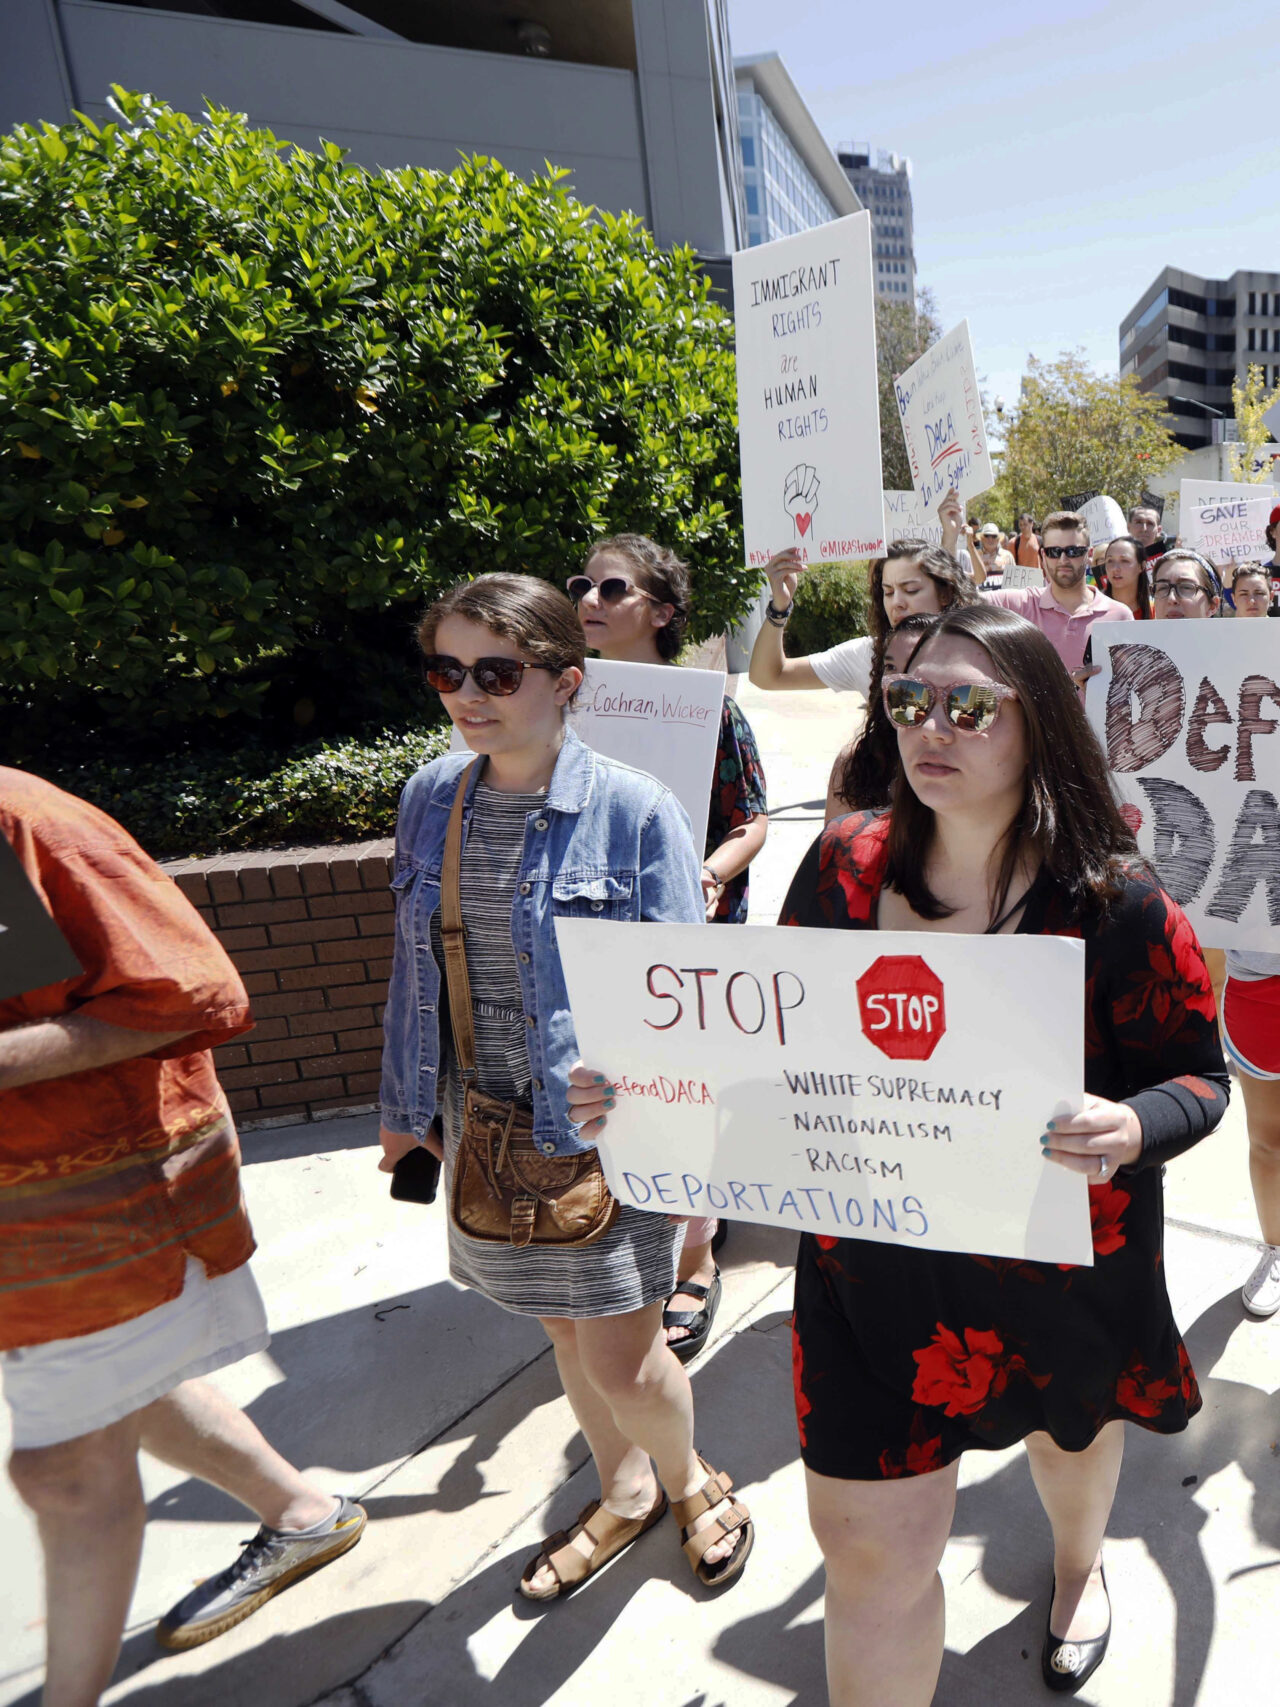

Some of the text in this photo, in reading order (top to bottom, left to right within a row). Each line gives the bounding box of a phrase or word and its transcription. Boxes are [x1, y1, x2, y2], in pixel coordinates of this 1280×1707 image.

[751, 259, 840, 307] IMMIGRANT
[772, 301, 822, 338] RIGHTS
[780, 353, 798, 374] are
[764, 374, 817, 410] HUMAN
[778, 408, 829, 441] RIGHTS
[924, 413, 956, 462] DACA
[884, 494, 909, 512] WE
[1200, 502, 1248, 524] SAVE
[1205, 530, 1266, 547] DREAMER
[1220, 521, 1250, 533] OUR
[1220, 545, 1251, 558] NEED
[593, 683, 716, 721] Cochran, Wicker
[643, 964, 939, 1046] STOP STOP
[867, 1074, 1002, 1111] SUPREMACY
[622, 1171, 929, 1238] DEPORTATIONS
